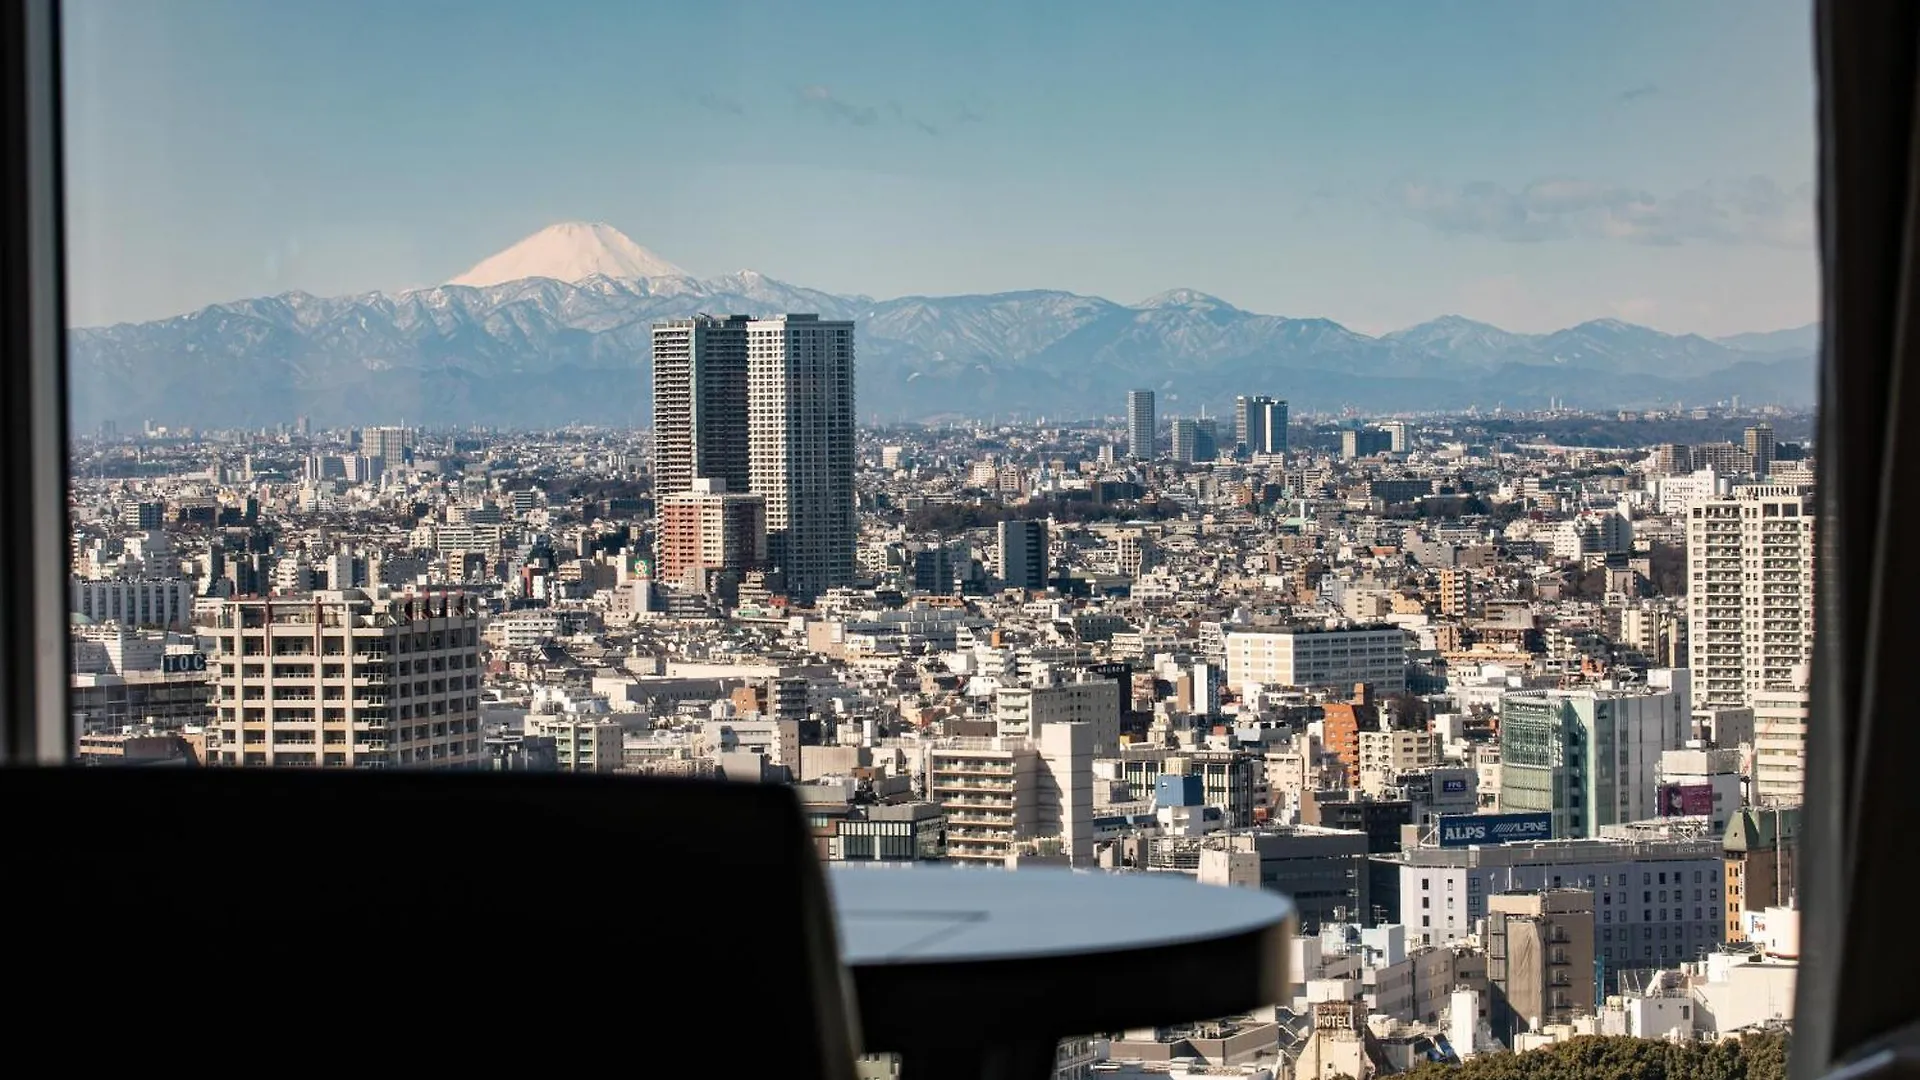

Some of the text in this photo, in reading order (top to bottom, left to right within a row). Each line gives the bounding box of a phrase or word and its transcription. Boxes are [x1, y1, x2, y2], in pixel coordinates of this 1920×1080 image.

[166, 655, 204, 671] TOC
[1445, 826, 1486, 840] ALPS
[1492, 821, 1547, 833] ALPINE
[1319, 1015, 1349, 1028] HOTEL
